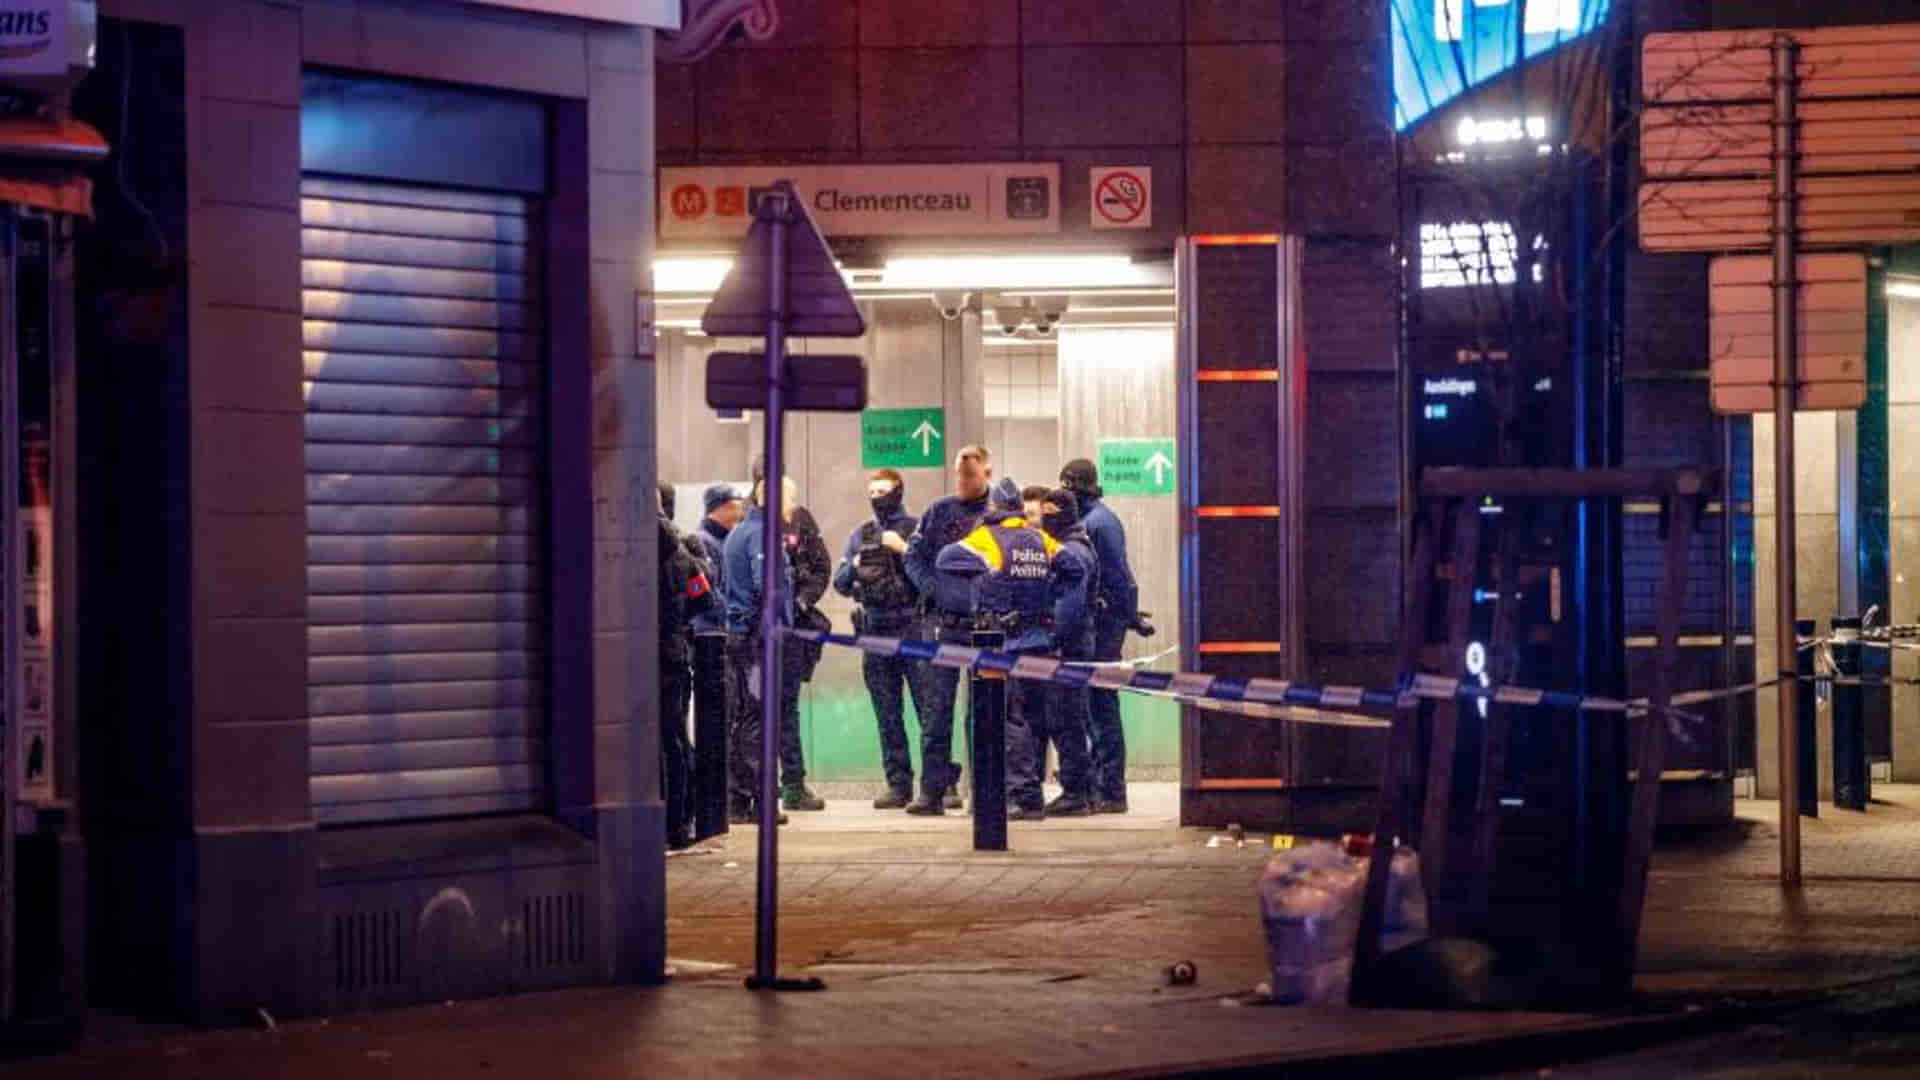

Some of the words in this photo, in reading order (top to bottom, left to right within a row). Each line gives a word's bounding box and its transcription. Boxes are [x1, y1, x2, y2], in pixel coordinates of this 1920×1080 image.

[814, 188, 972, 212] Clemenceau
[1011, 548, 1047, 562] Police
[1009, 563, 1049, 577] Politie
